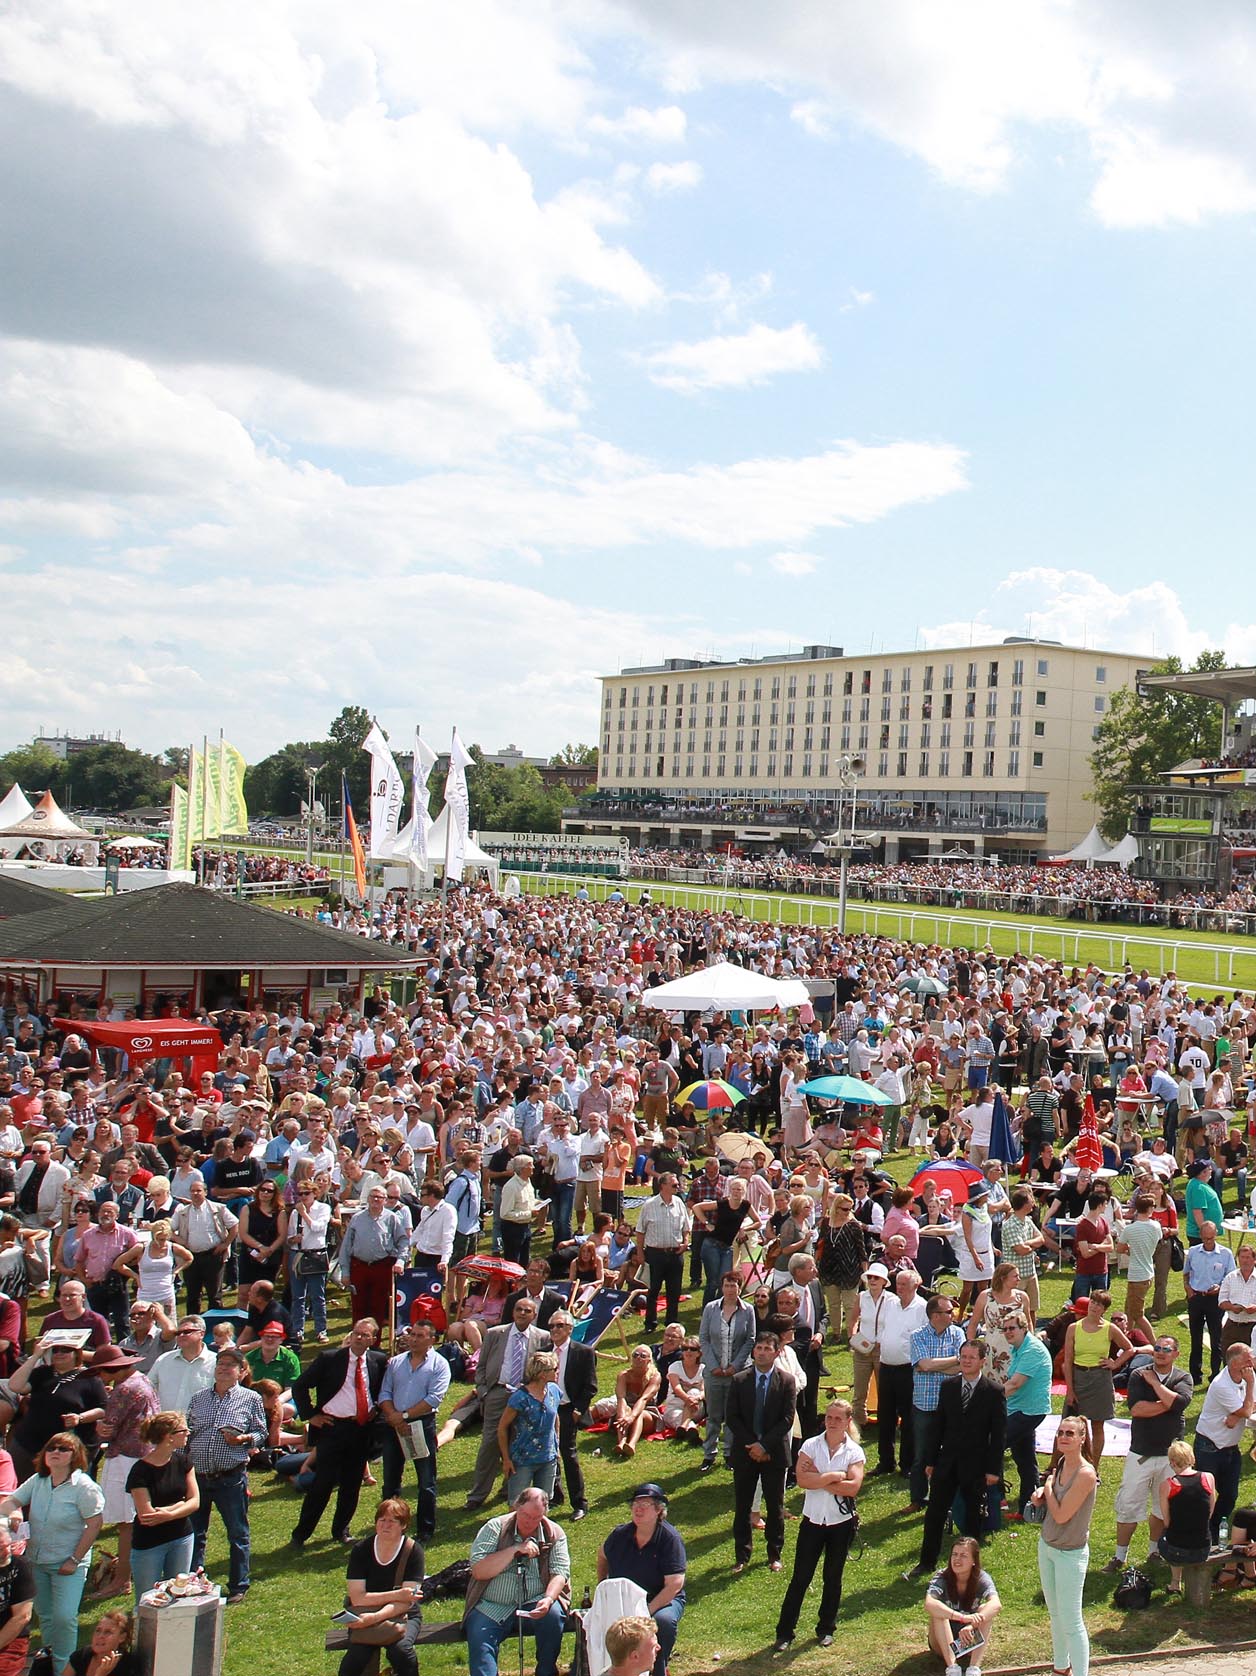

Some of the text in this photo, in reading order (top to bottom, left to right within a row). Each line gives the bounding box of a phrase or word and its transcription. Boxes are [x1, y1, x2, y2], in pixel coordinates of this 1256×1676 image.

[513, 833, 583, 843] IDEE KAFFEE
[1190, 1058, 1202, 1068] 10
